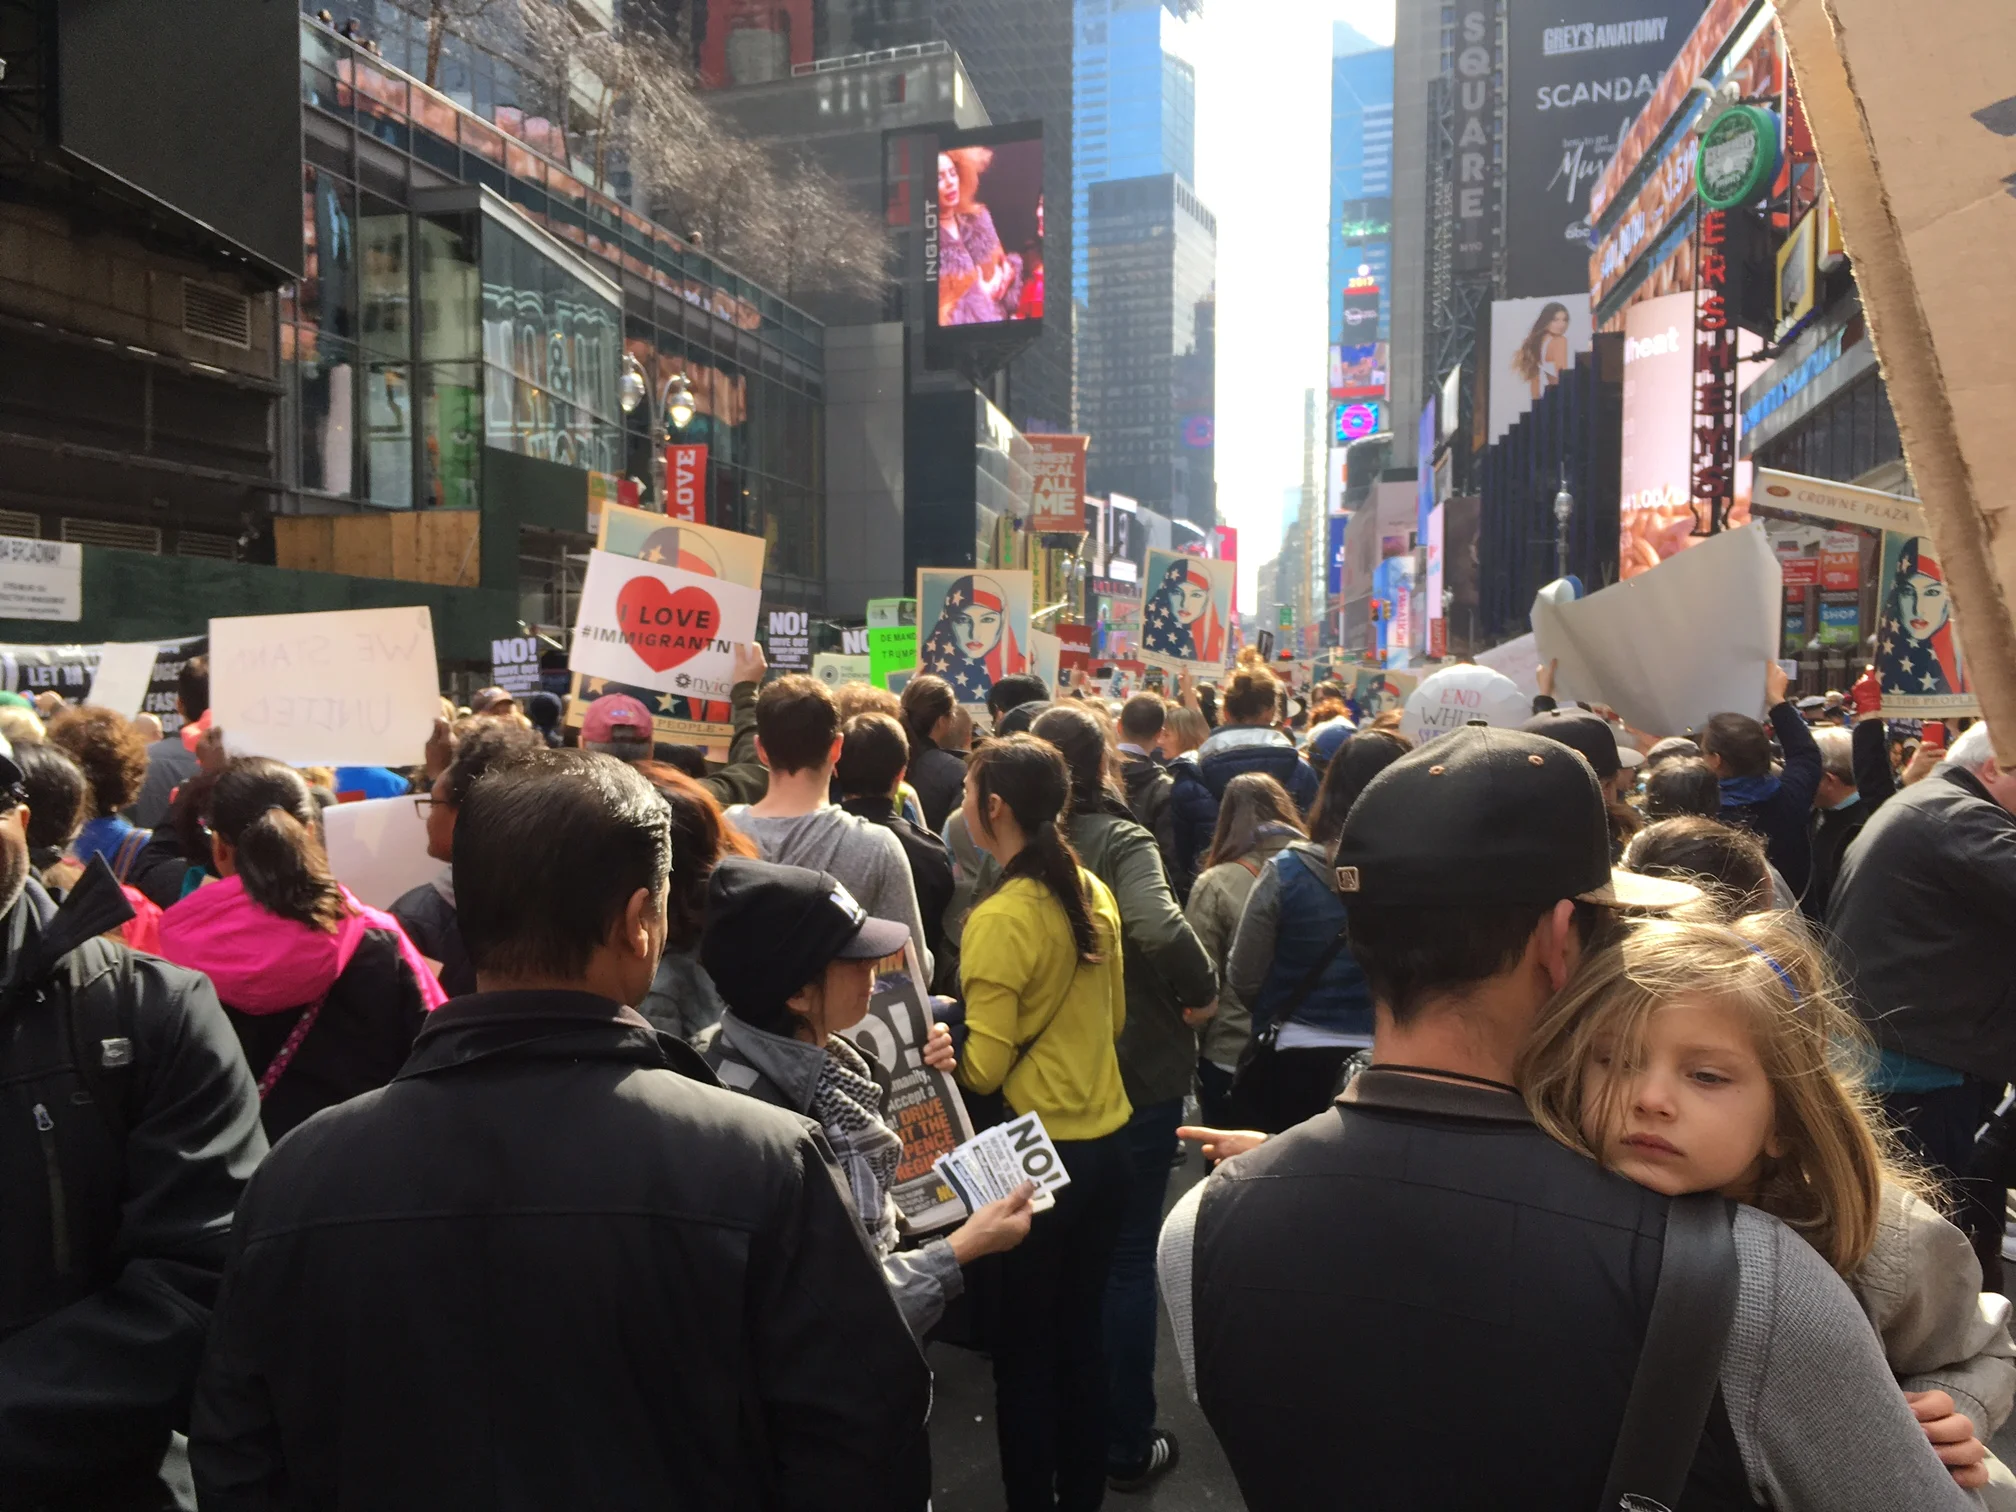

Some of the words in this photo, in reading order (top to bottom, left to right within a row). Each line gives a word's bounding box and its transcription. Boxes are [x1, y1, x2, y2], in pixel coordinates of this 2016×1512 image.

[1543, 22, 1594, 55] GREY'S
[1596, 16, 1668, 48] ANATOMY
[1458, 11, 1491, 218] SQUARE
[925, 201, 937, 281] INGLOT
[676, 450, 696, 521] LOVE
[1798, 490, 1857, 511] CROWNE
[1864, 503, 1910, 522] PLAZA
[1824, 554, 1856, 565] PLAY
[621, 604, 628, 622] I
[640, 606, 711, 629] LOVE
[768, 612, 808, 635] NO!
[1823, 609, 1857, 621] SHOP
[493, 637, 537, 664] NO!
[582, 624, 744, 654] #IMMIGRANTN
[1440, 688, 1482, 708] END
[658, 718, 716, 732] PEOPLE
[928, 1086, 936, 1097] a
[901, 1099, 944, 1124] DRIVE
[920, 1113, 950, 1136] THE
[1007, 1119, 1062, 1187] NO!
